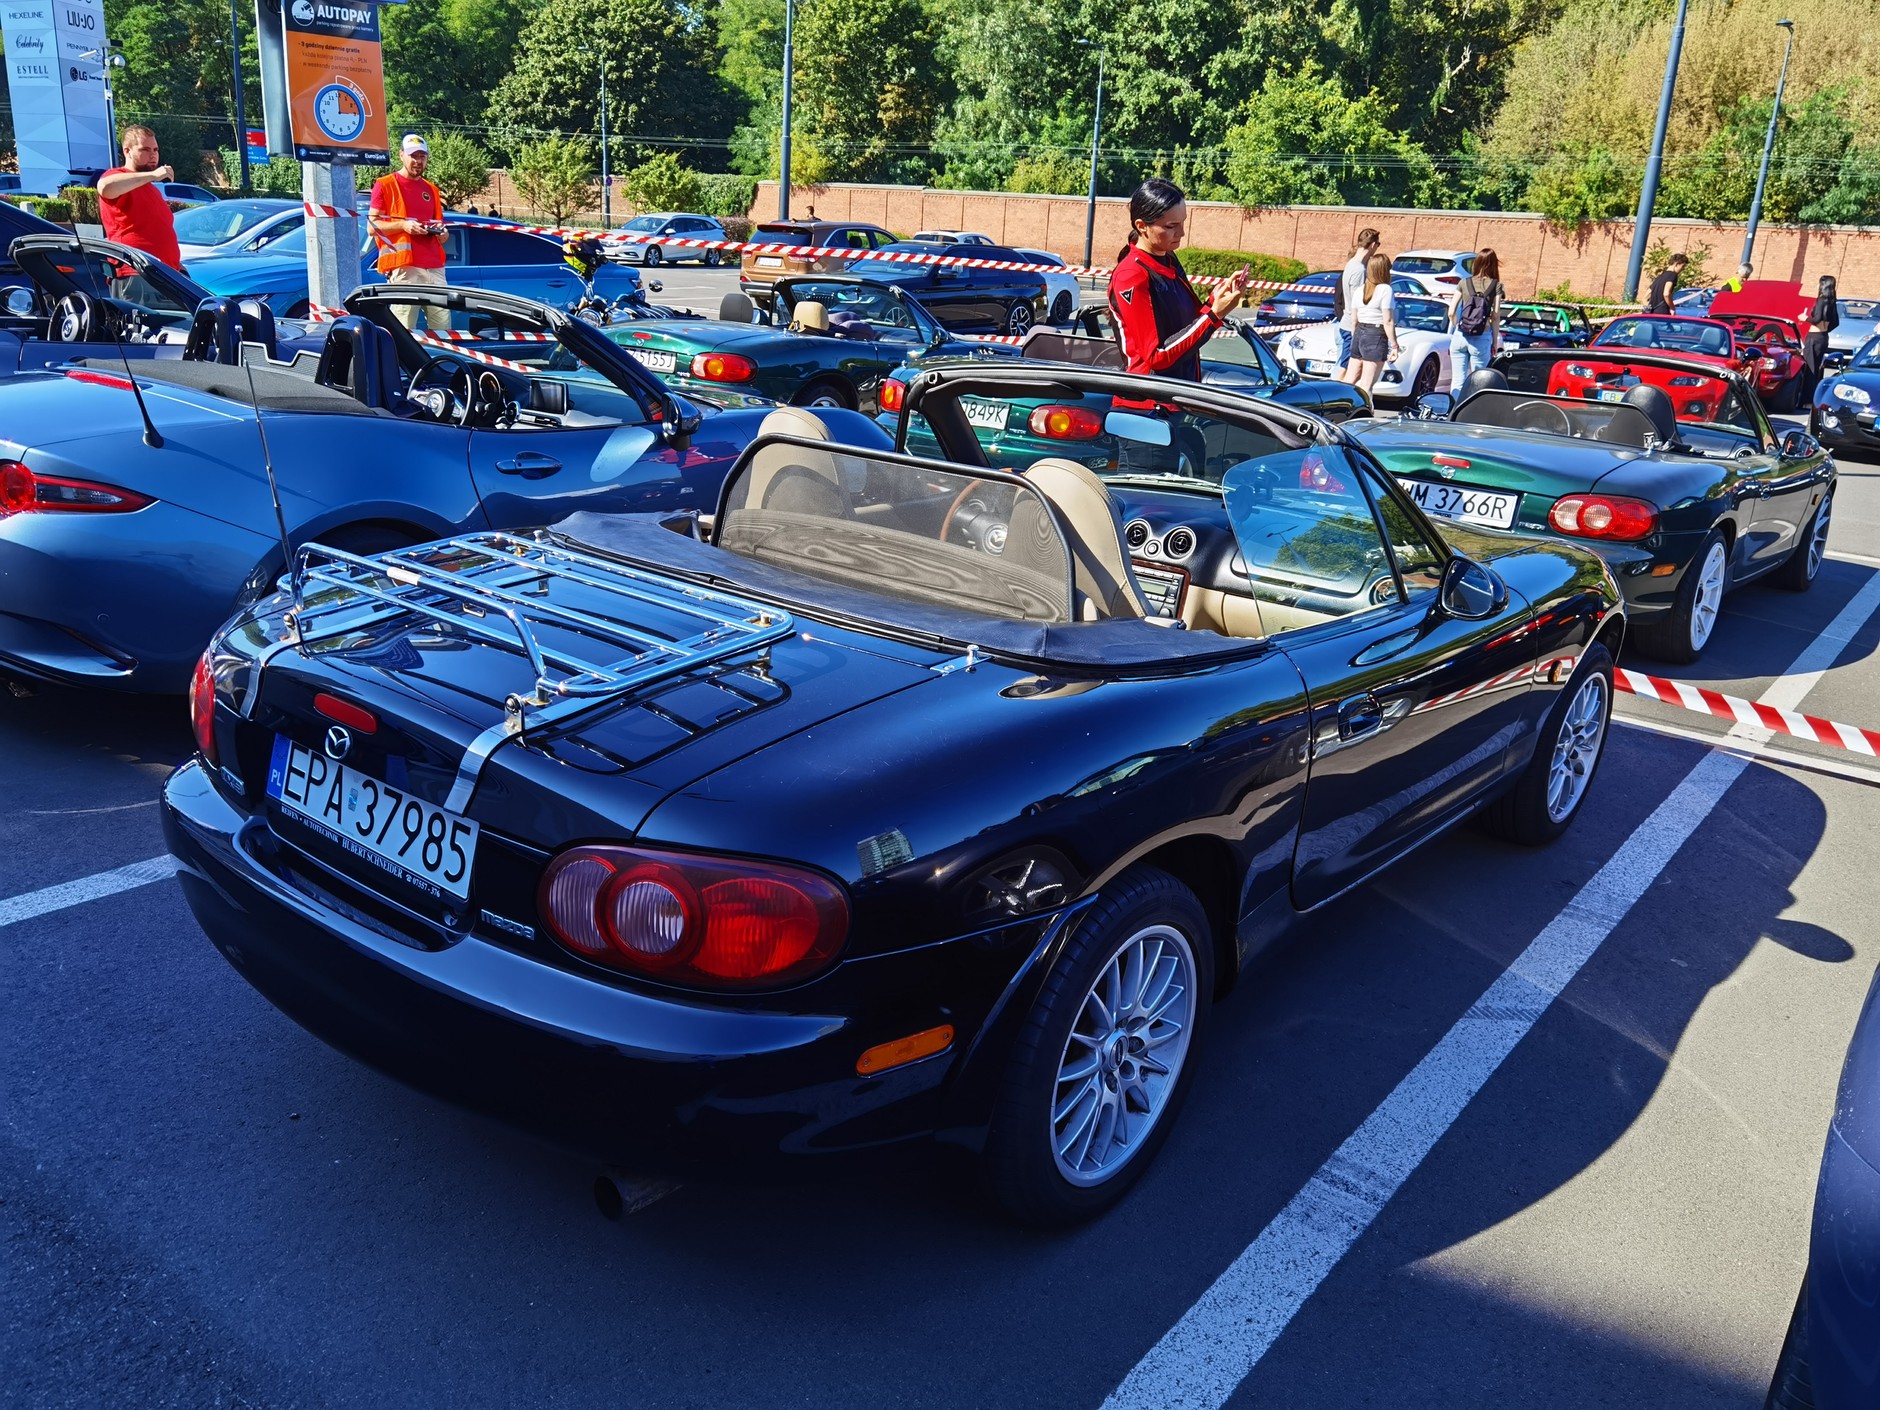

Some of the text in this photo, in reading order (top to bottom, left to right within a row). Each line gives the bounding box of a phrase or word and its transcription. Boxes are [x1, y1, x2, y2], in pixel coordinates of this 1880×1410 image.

[9, 11, 44, 19] HEXELINE
[317, 5, 371, 24] AUTOPAY
[305, 42, 325, 50] godziny
[17, 65, 49, 74] ESTELL
[79, 71, 88, 81] LG
[1435, 488, 1507, 519] 3766R
[271, 769, 282, 787] PL
[284, 742, 472, 883] EPA 37985
[281, 805, 299, 820] REIFEN
[303, 818, 339, 843] AUTOTECHNIK
[342, 838, 366, 858] HUBERT
[366, 851, 403, 878] SCHNEIDER
[480, 908, 535, 941] mazda
